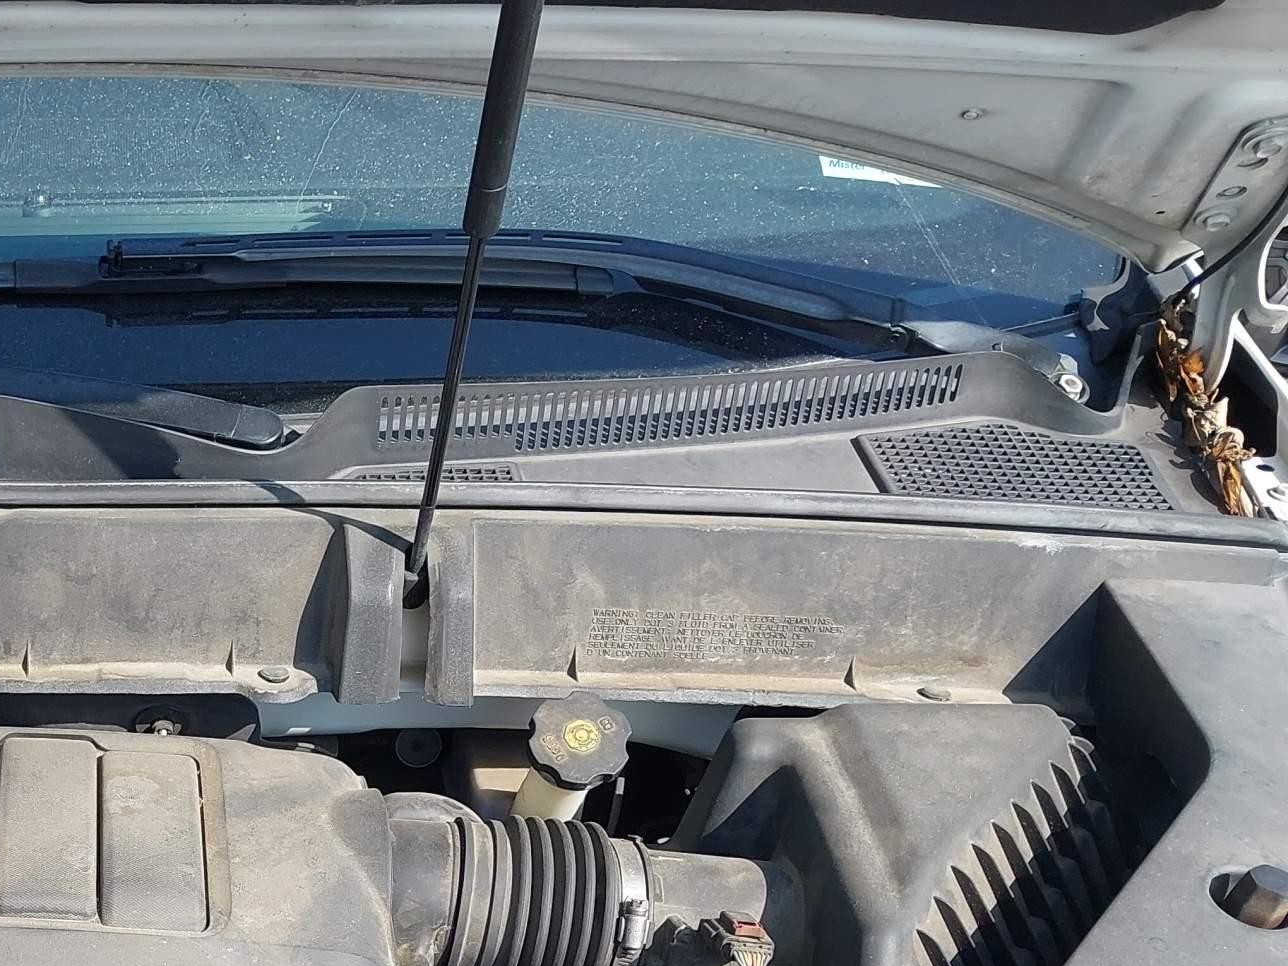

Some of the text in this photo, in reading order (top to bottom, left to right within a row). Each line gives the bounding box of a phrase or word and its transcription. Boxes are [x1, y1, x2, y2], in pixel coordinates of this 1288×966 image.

[645, 610, 677, 620] CLEAN
[679, 611, 716, 621] FILLER
[743, 614, 780, 623] BEFORE
[591, 617, 613, 625] USE
[615, 618, 640, 627] ONLY
[643, 619, 664, 627] DOT
[679, 620, 709, 629] FLUID
[713, 622, 739, 631] FROM
[743, 623, 752, 631] A
[754, 624, 790, 633] SEALED
[692, 637, 707, 645] DE
[728, 630, 743, 639] LE
[792, 633, 806, 642] DE
